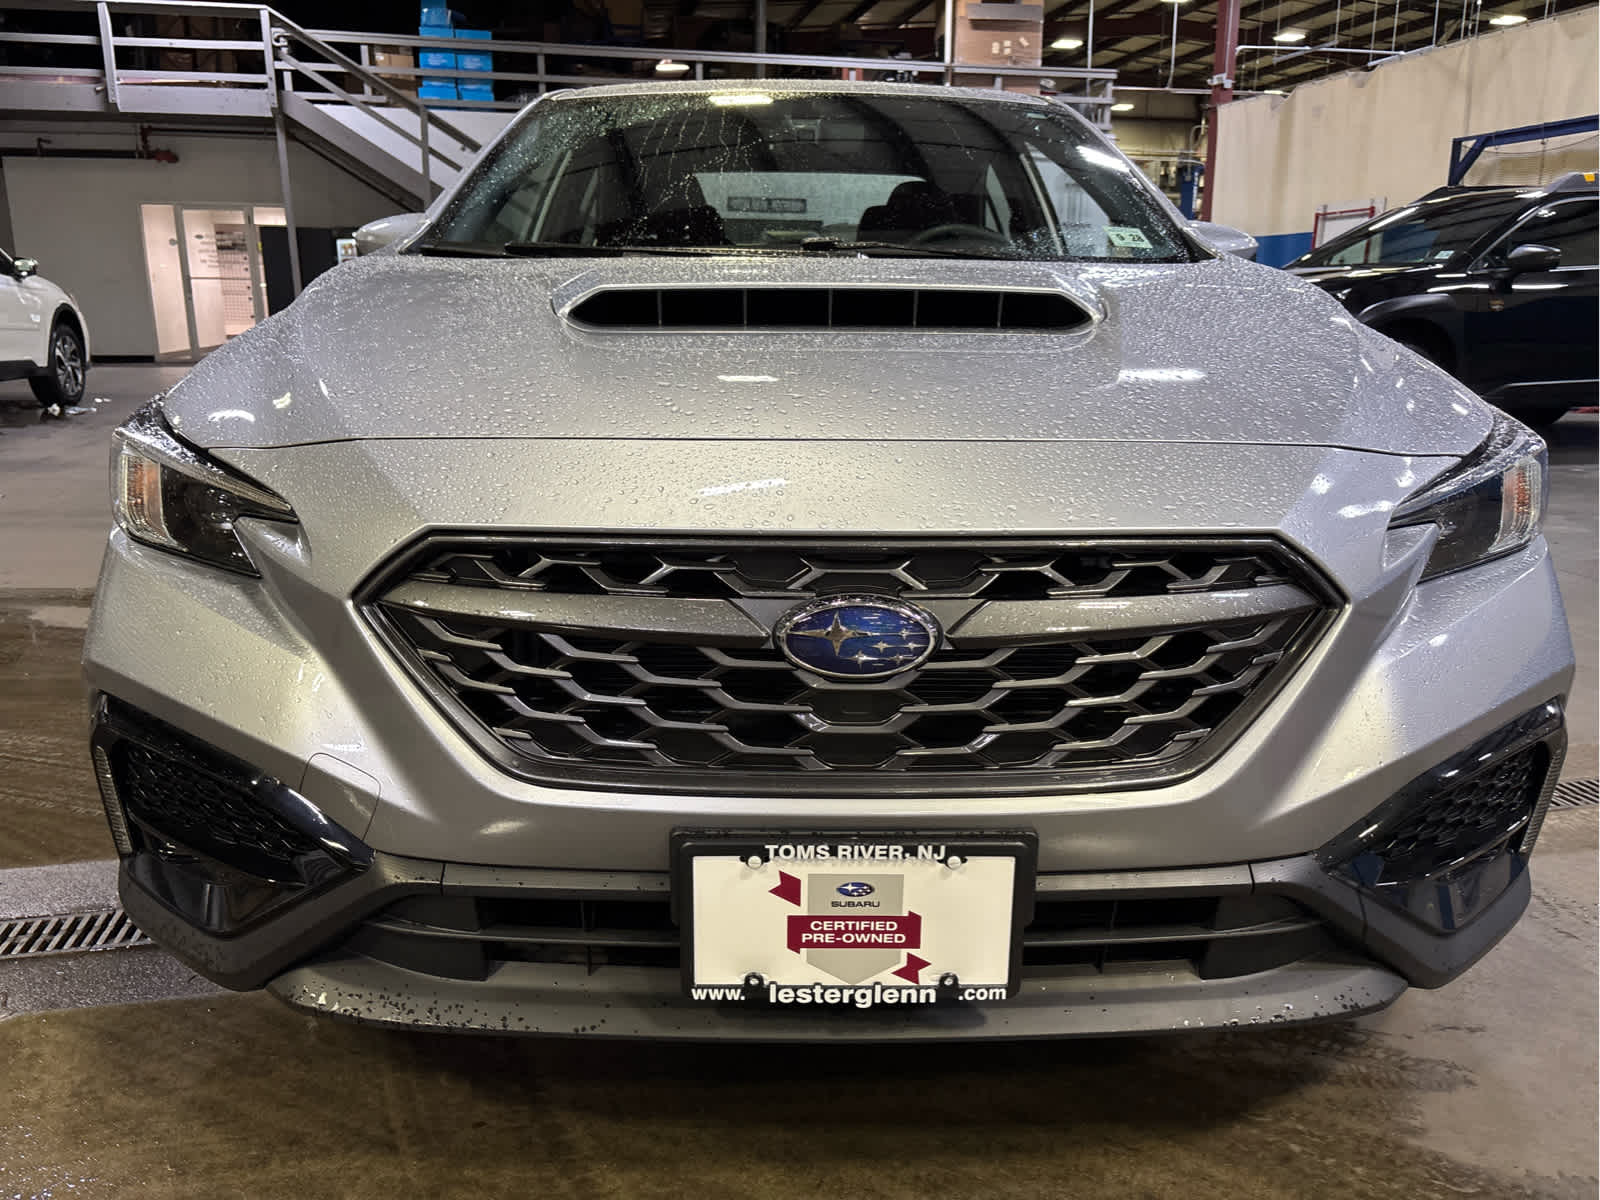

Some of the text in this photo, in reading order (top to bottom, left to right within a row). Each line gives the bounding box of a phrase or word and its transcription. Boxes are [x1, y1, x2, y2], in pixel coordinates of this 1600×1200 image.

[765, 845, 830, 859] TOMS
[917, 845, 946, 860] NJ
[810, 921, 898, 931] CERTIFIED
[801, 933, 906, 943] PRE-OWNED
[691, 984, 1007, 1009] www. lesterglenn .com
